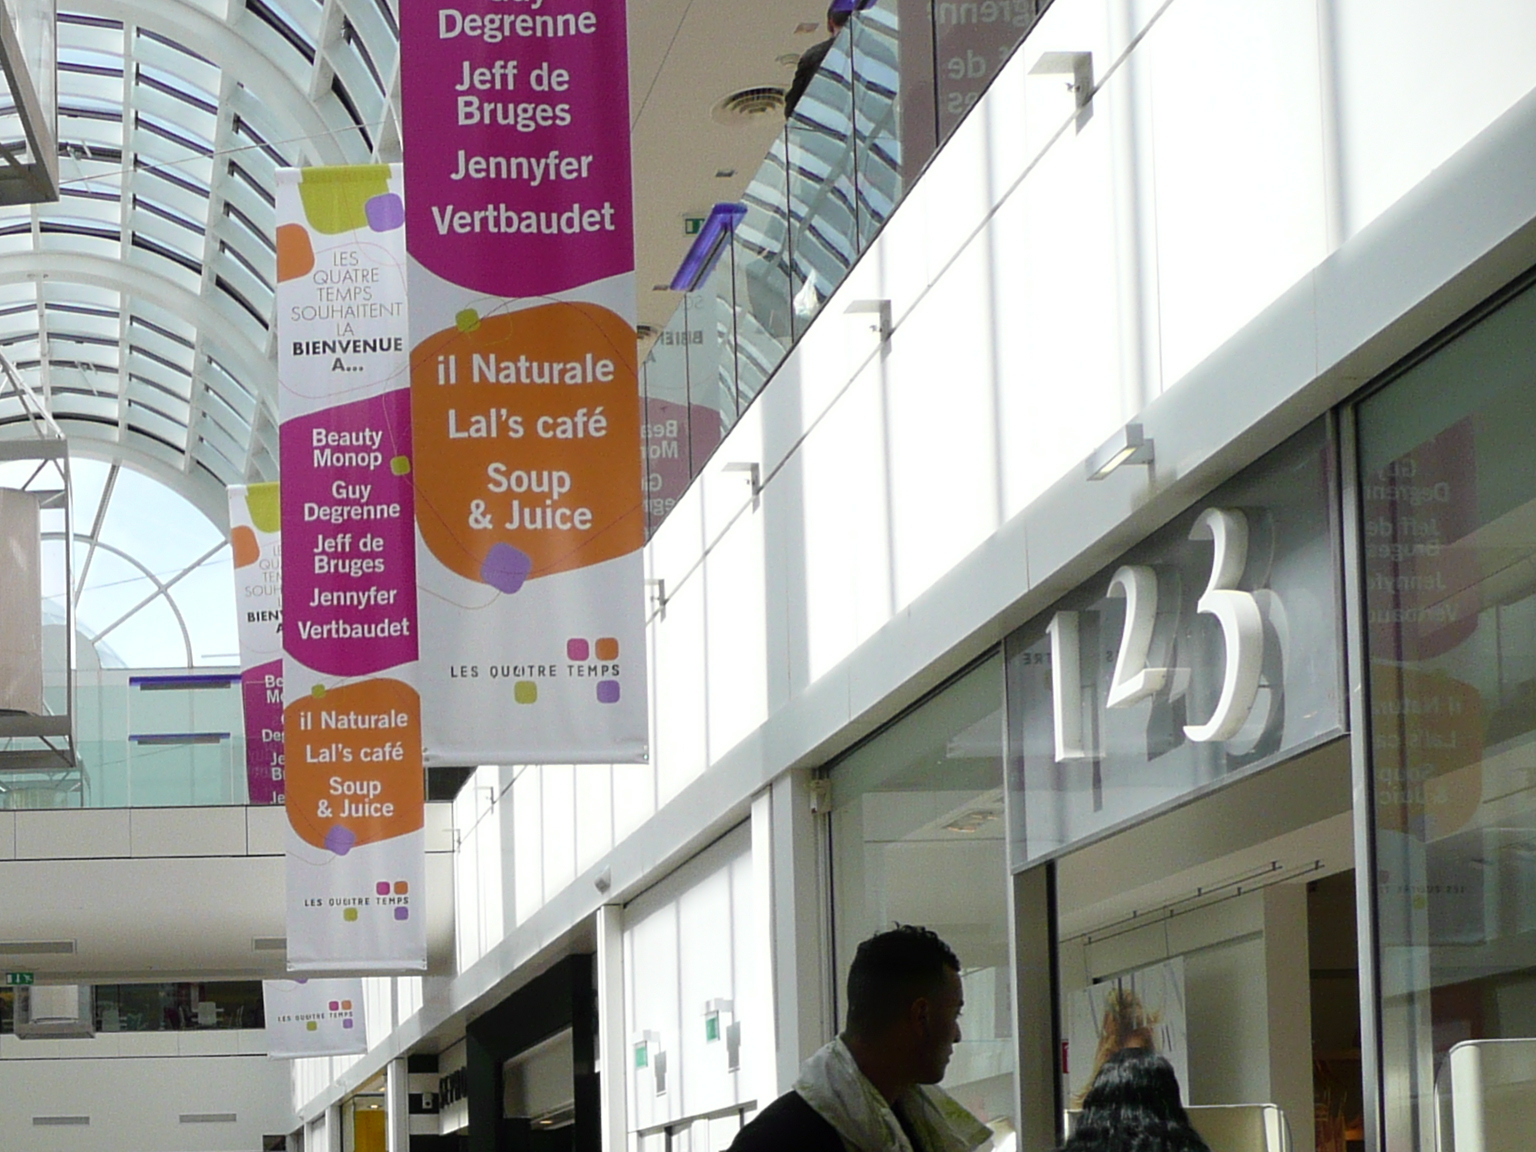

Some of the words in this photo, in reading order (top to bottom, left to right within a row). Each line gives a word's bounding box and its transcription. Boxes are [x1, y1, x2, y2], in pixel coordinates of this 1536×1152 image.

[439, 9, 596, 43] Degrenne
[455, 60, 517, 91] Jeff
[530, 62, 570, 91] de
[457, 96, 571, 132] Bruges
[450, 150, 593, 186] Jennyfer
[431, 202, 615, 235] Vertbaudet
[334, 252, 359, 266] LES
[313, 268, 379, 285] QUATRE
[317, 286, 372, 302] TEMPS
[291, 302, 403, 321] SOUHAITENT
[337, 322, 354, 337] LA
[293, 338, 403, 356] BIENVENUE
[437, 355, 456, 385] il
[472, 353, 615, 385] Naturale
[536, 407, 608, 439] café
[312, 428, 383, 449] Beauty
[313, 449, 382, 470] Monop
[332, 481, 371, 502] Guy
[487, 462, 571, 500] Soup
[304, 503, 401, 524] Degrenne
[468, 500, 493, 530] &
[504, 500, 592, 530] Juice
[313, 534, 352, 553] Jeff
[359, 533, 384, 551] de
[314, 555, 385, 577] Bruges
[309, 586, 397, 609] Jennyfer
[298, 618, 410, 639] Vertbaudet
[450, 666, 479, 678] LES
[567, 664, 621, 678] TEMPS
[300, 711, 312, 730] il
[320, 709, 408, 729] Naturale
[360, 742, 404, 761] café
[329, 777, 381, 798] Soup
[317, 799, 332, 817] &
[339, 798, 394, 817] Juice
[304, 899, 322, 907] LES
[376, 897, 409, 905] TEMPS
